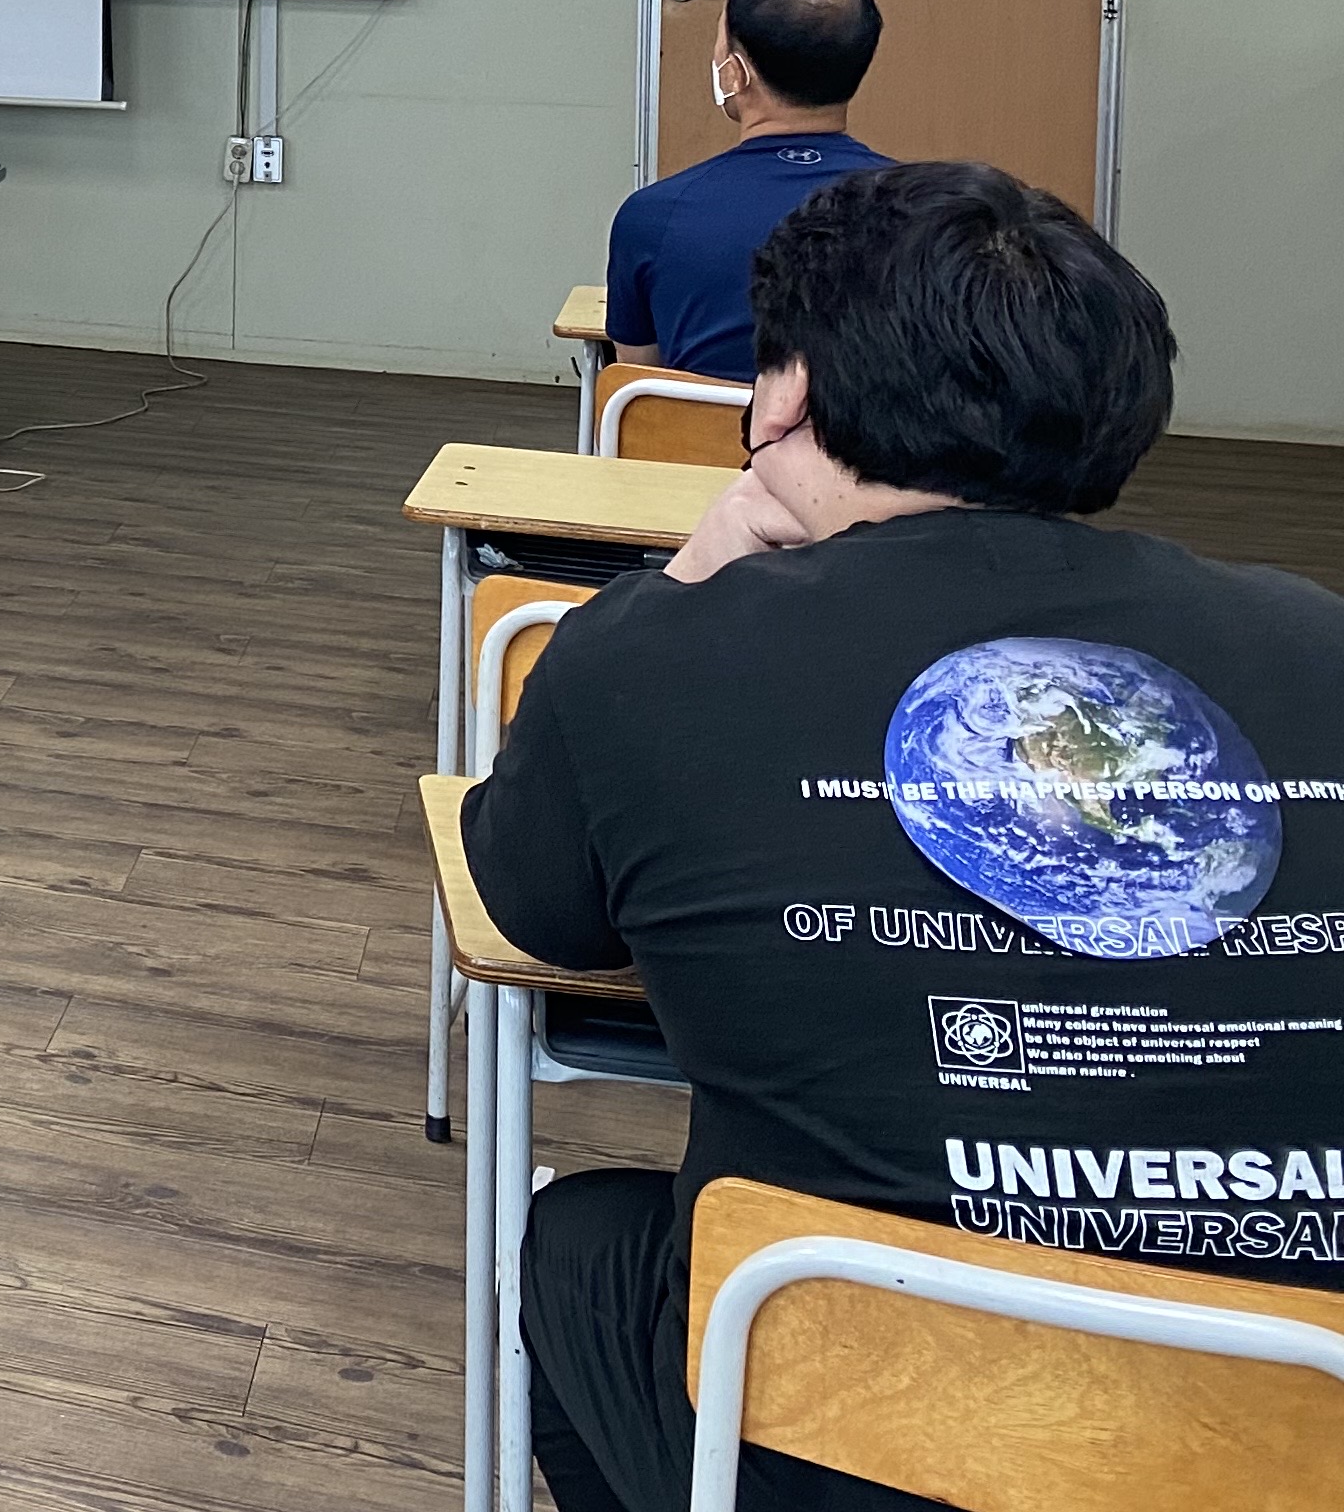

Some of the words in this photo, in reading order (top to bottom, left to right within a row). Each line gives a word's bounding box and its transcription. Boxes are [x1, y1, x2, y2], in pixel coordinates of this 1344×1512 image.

[800, 779, 811, 799] I
[817, 779, 895, 802] MUST
[901, 782, 939, 801] BE
[941, 781, 994, 800] THE
[1000, 781, 1128, 801] HAPPIEST
[1132, 781, 1242, 801] PERSON
[1245, 782, 1281, 803] ON
[783, 903, 856, 941] OF
[868, 906, 1210, 958] UNIVERSAL
[1021, 1002, 1087, 1016] universal
[1090, 1004, 1168, 1018] gravitation
[1023, 1016, 1061, 1030] Many
[1065, 1018, 1110, 1031] colors
[1113, 1018, 1147, 1032] have
[1150, 1021, 1215, 1033] universal
[1217, 1019, 1286, 1033] emotional
[1287, 1018, 1343, 1031] meaning
[1024, 1032, 1043, 1044] be
[1046, 1033, 1070, 1045] the
[1074, 1035, 1119, 1048] object
[1122, 1036, 1137, 1047] of
[1141, 1037, 1205, 1048] universal
[1209, 1037, 1260, 1049] respect
[1026, 1048, 1049, 1059] We
[1052, 1049, 1083, 1061] also
[1086, 1051, 1124, 1062] learn
[1127, 1052, 1203, 1065] something
[1205, 1052, 1246, 1063] about
[1028, 1063, 1077, 1076] human
[1079, 1065, 1127, 1077] nature
[938, 1072, 1032, 1091] UNIVERSAL
